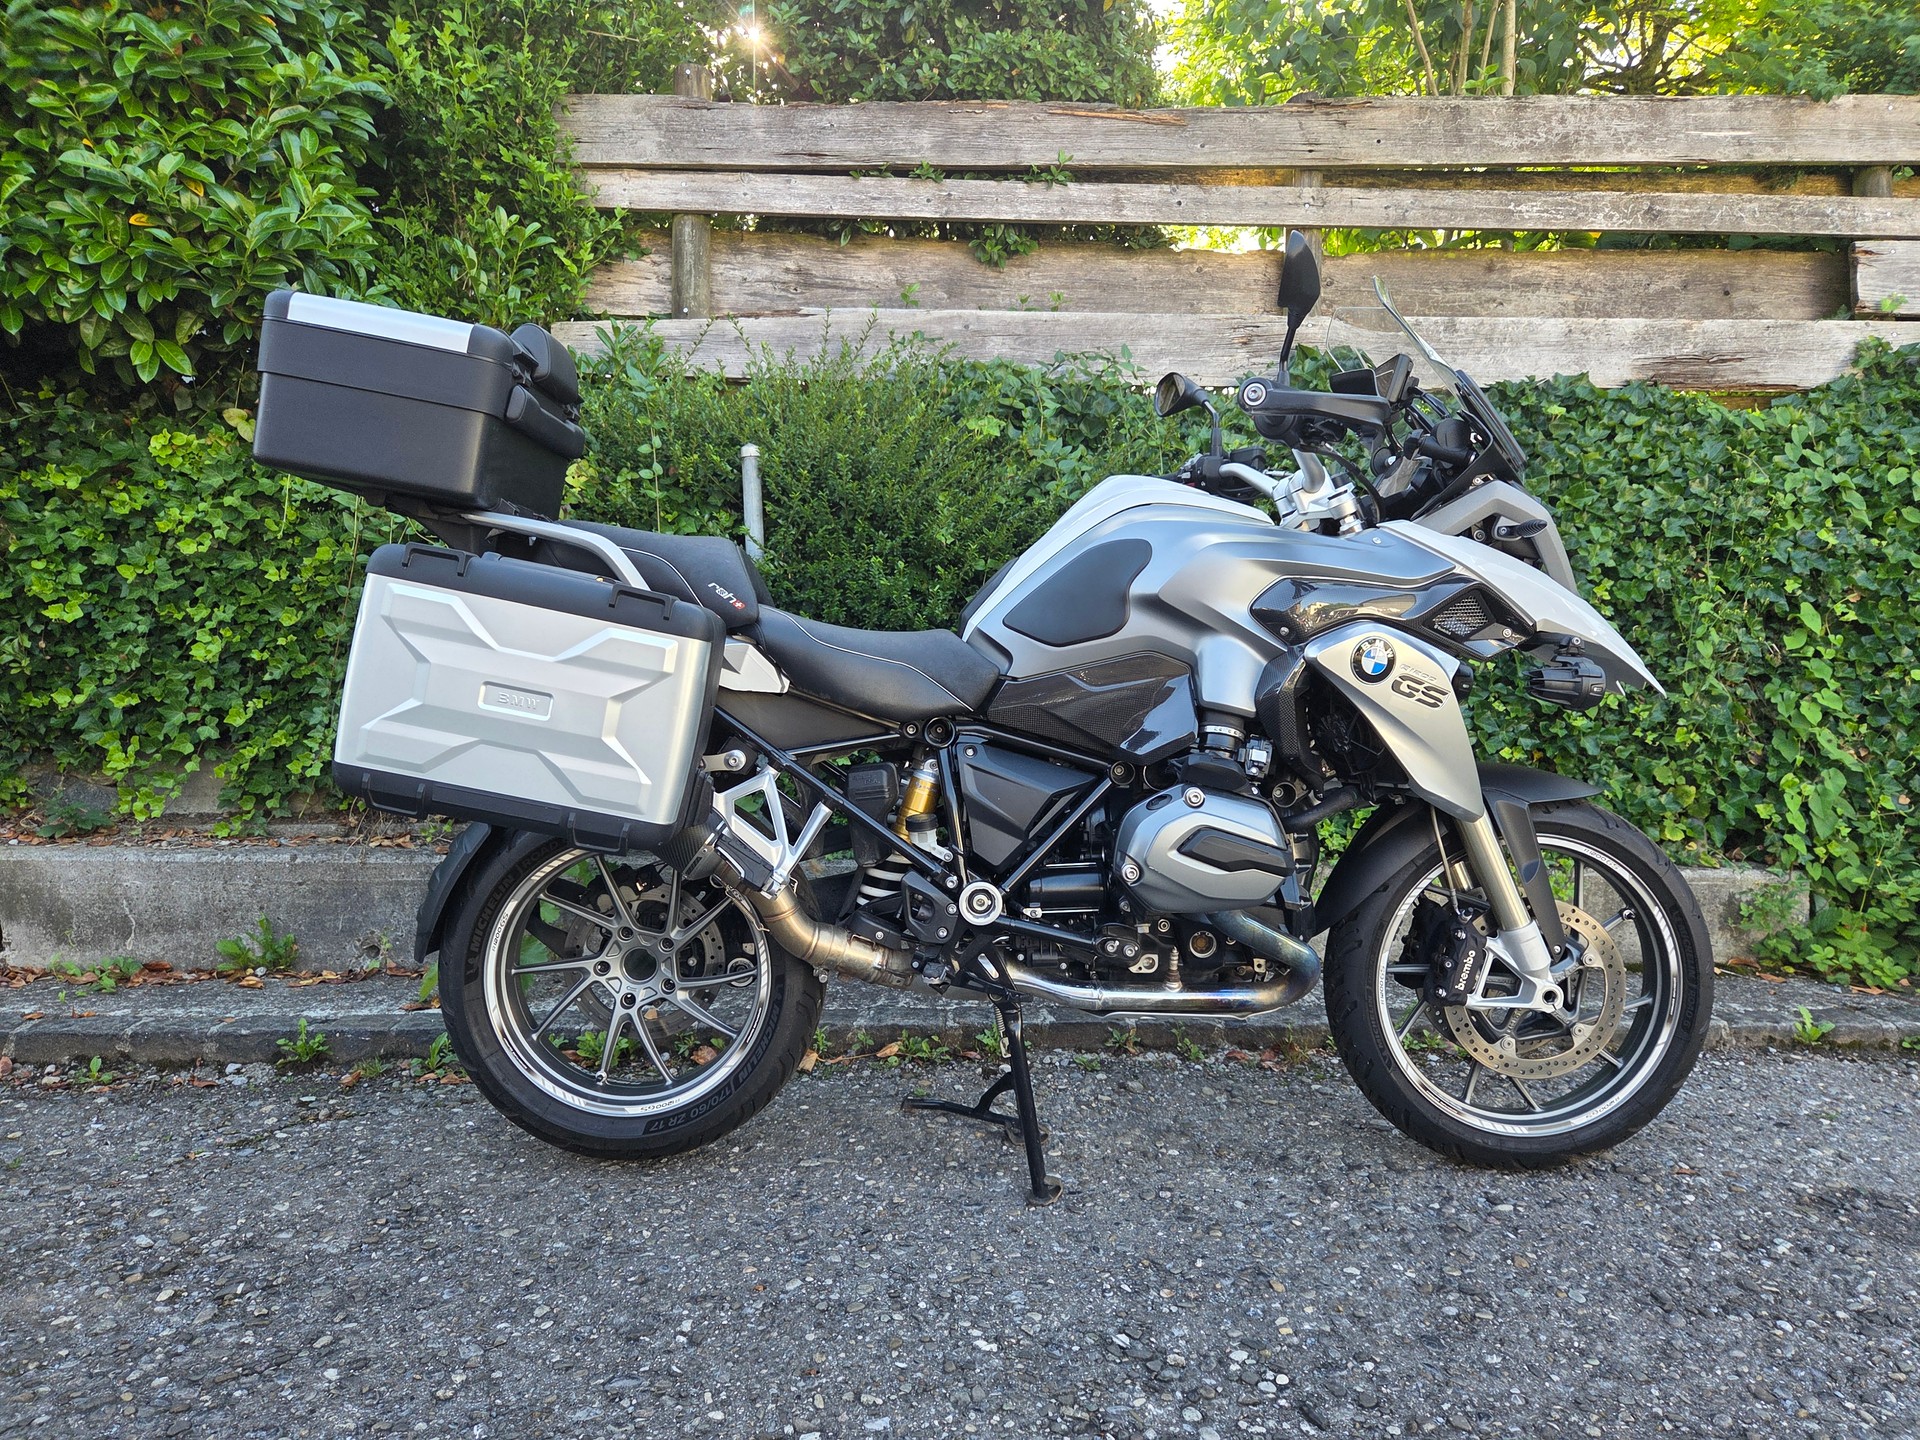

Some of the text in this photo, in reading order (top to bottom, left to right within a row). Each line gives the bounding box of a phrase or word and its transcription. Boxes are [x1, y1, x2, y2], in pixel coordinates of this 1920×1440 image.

[1359, 639, 1394, 658] BMW
[498, 692, 540, 709] BMW
[1391, 675, 1449, 709] GS
[470, 876, 512, 953] MICHELIN
[1455, 950, 1476, 991] brembo
[650, 1002, 780, 1132] MICHELIN 170/60 ZR 17
